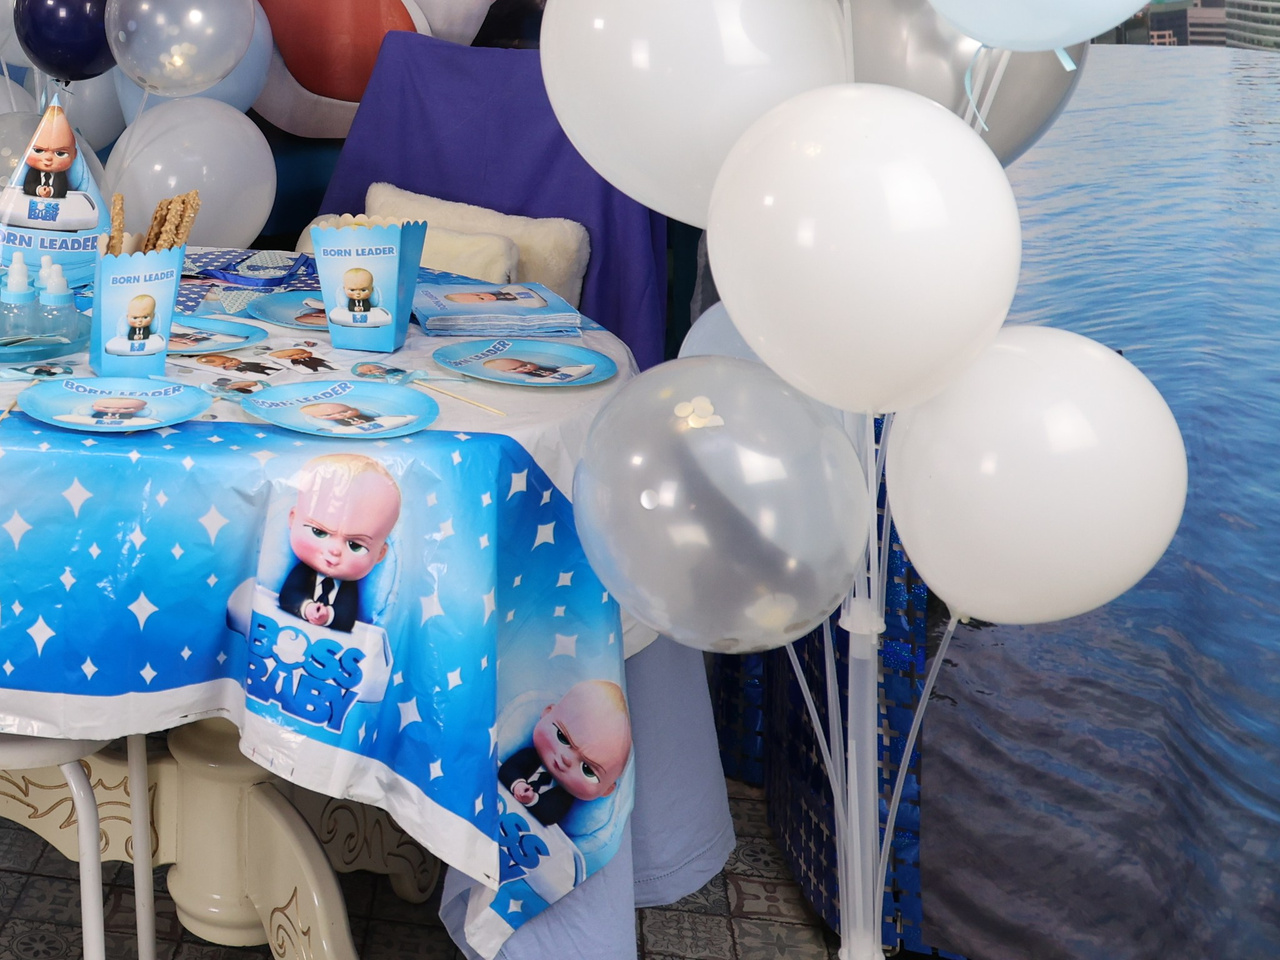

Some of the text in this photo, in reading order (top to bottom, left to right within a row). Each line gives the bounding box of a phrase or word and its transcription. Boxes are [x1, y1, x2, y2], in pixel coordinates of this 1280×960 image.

[322, 246, 395, 257] BORN LEADER
[111, 270, 175, 285] BORN LEADER
[64, 380, 182, 397] BORN LEADER
[296, 381, 352, 404] LEADER
[249, 609, 366, 689] BOSS
[246, 657, 360, 733] BABY
